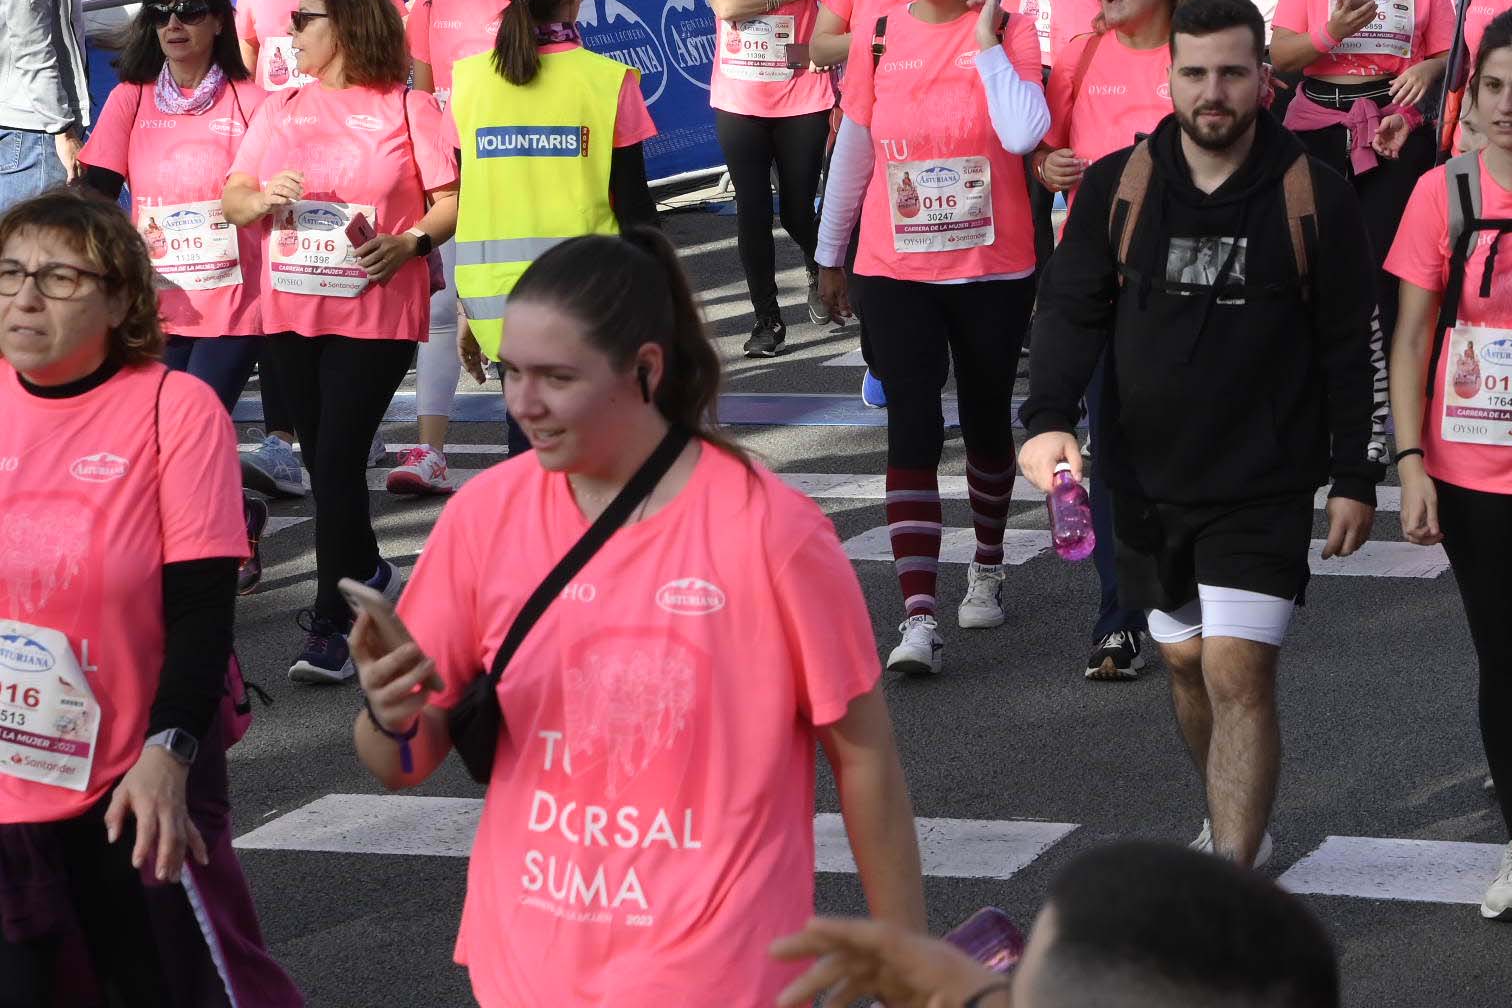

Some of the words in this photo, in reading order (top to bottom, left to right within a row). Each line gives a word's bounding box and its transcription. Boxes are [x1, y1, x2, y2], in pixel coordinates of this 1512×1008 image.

[586, 33, 615, 48] CENTRAL
[744, 40, 768, 51] 016
[884, 58, 924, 73] OYSHO
[478, 134, 578, 151] VOLUNTARIS
[880, 139, 909, 160] TU
[919, 174, 957, 186] ASTURIANA
[923, 195, 957, 210] 016
[927, 212, 954, 223] 30247
[940, 223, 947, 231] LA
[949, 222, 969, 230] MUJER
[171, 237, 203, 251] 016
[904, 237, 934, 247] OYSHO
[956, 232, 987, 243] Santander
[302, 238, 335, 252] 016
[156, 265, 177, 274] ARRERA
[279, 265, 302, 273] CARRERA
[277, 277, 304, 287] OYSHO
[328, 281, 361, 290] Santander
[1457, 408, 1488, 418] CARRERA
[1488, 410, 1499, 419] DE
[1501, 411, 1511, 420] LA
[1453, 423, 1489, 435] OYSHO
[0, 647, 49, 669] STURIANA
[0, 683, 40, 709] 16
[3, 732, 15, 745] LA
[17, 734, 50, 749] MUJER
[24, 755, 76, 776] Santander
[521, 849, 649, 911] SUMA
